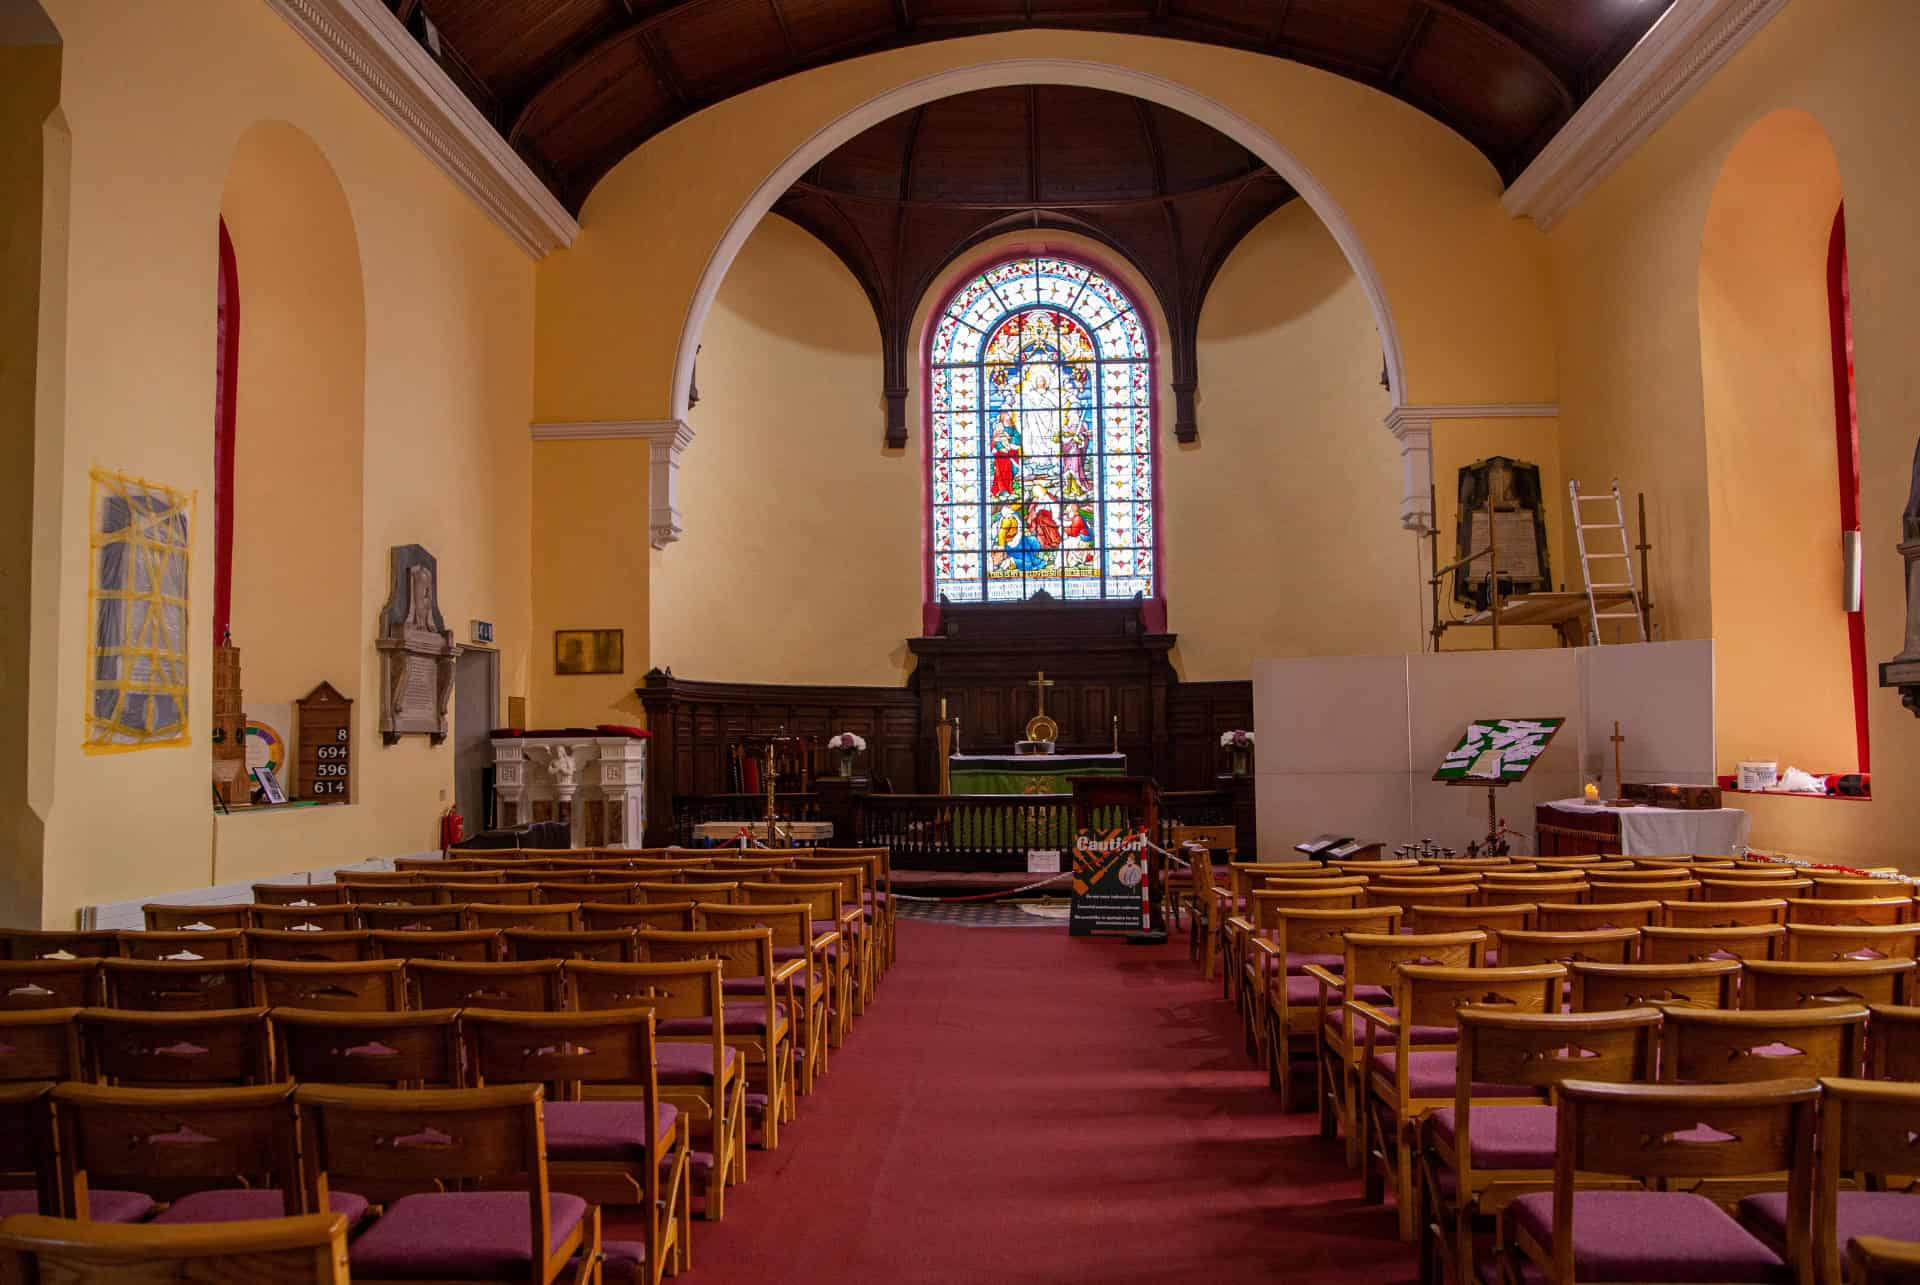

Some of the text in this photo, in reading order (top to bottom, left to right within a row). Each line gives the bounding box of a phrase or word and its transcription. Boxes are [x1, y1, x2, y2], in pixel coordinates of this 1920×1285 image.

[338, 729, 347, 741] 8
[318, 746, 347, 758] 694
[318, 764, 347, 776] 596
[314, 782, 345, 793] 614
[1077, 836, 1142, 851] Caution
